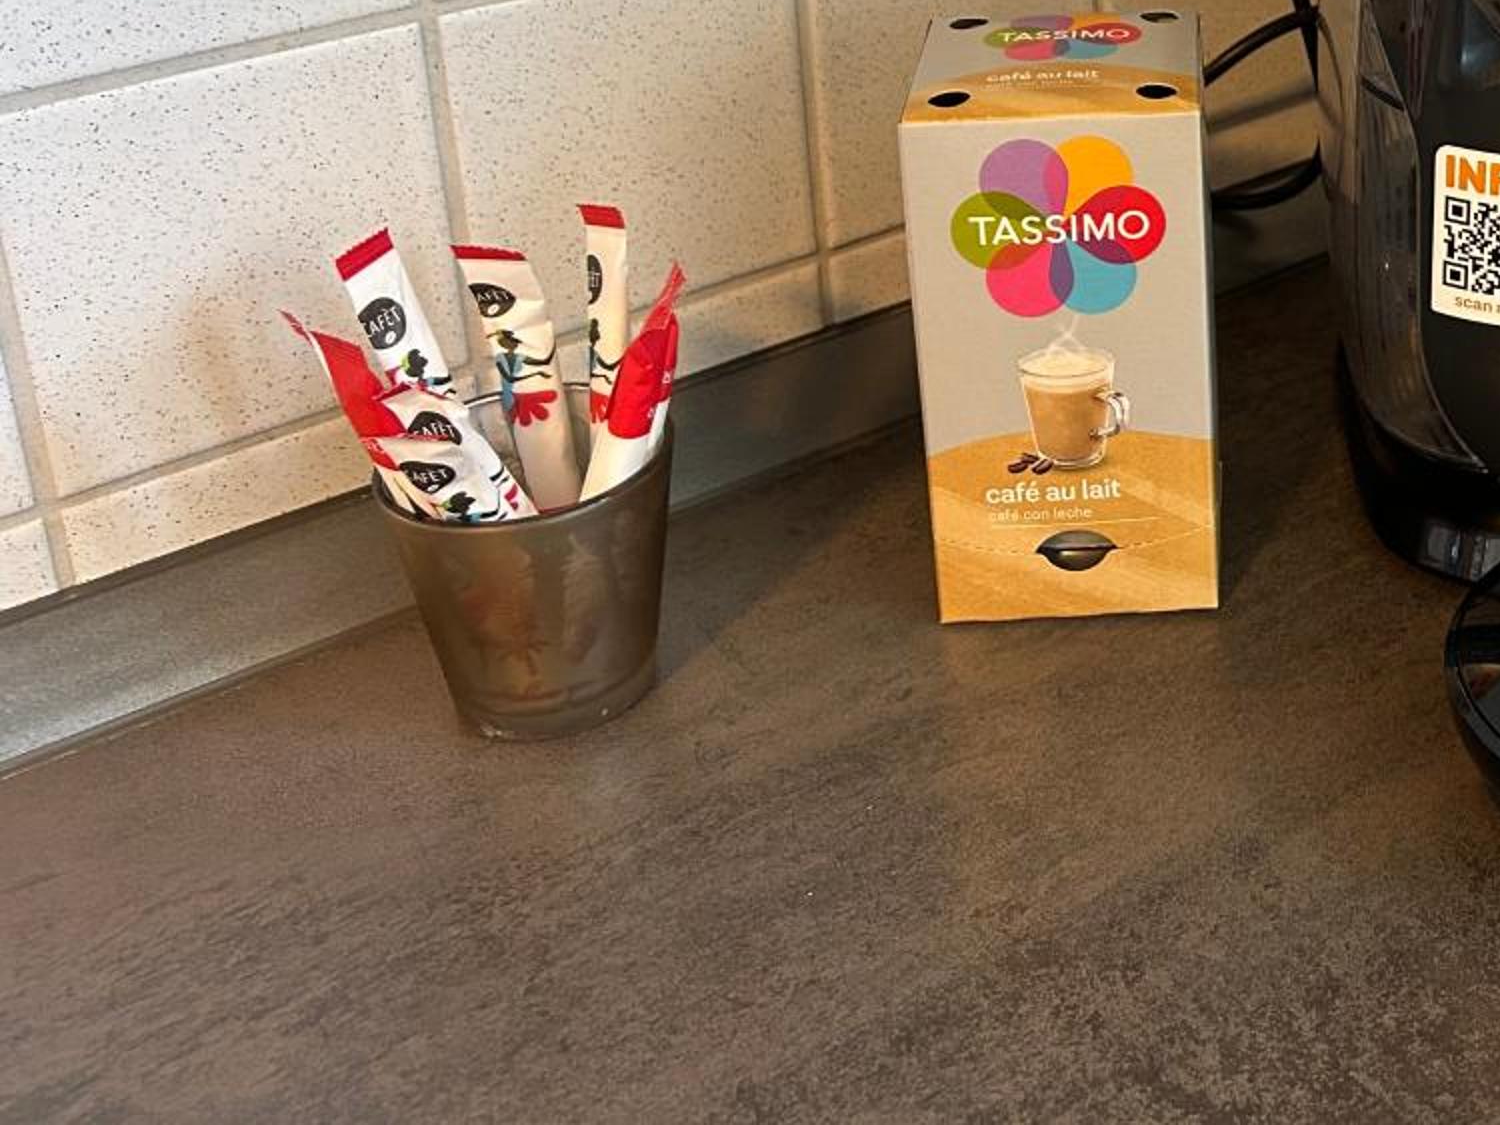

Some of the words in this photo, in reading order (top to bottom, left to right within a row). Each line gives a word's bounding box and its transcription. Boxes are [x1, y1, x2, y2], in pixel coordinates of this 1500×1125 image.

[998, 28, 1131, 43] TASSIMO
[967, 209, 1150, 246] TASSIMO
[1454, 296, 1493, 314] scan
[985, 480, 1041, 505] café
[1045, 485, 1077, 502] au
[1081, 478, 1122, 500] lait
[989, 508, 1020, 522] café
[1023, 510, 1051, 521] con
[1053, 506, 1093, 520] leche
